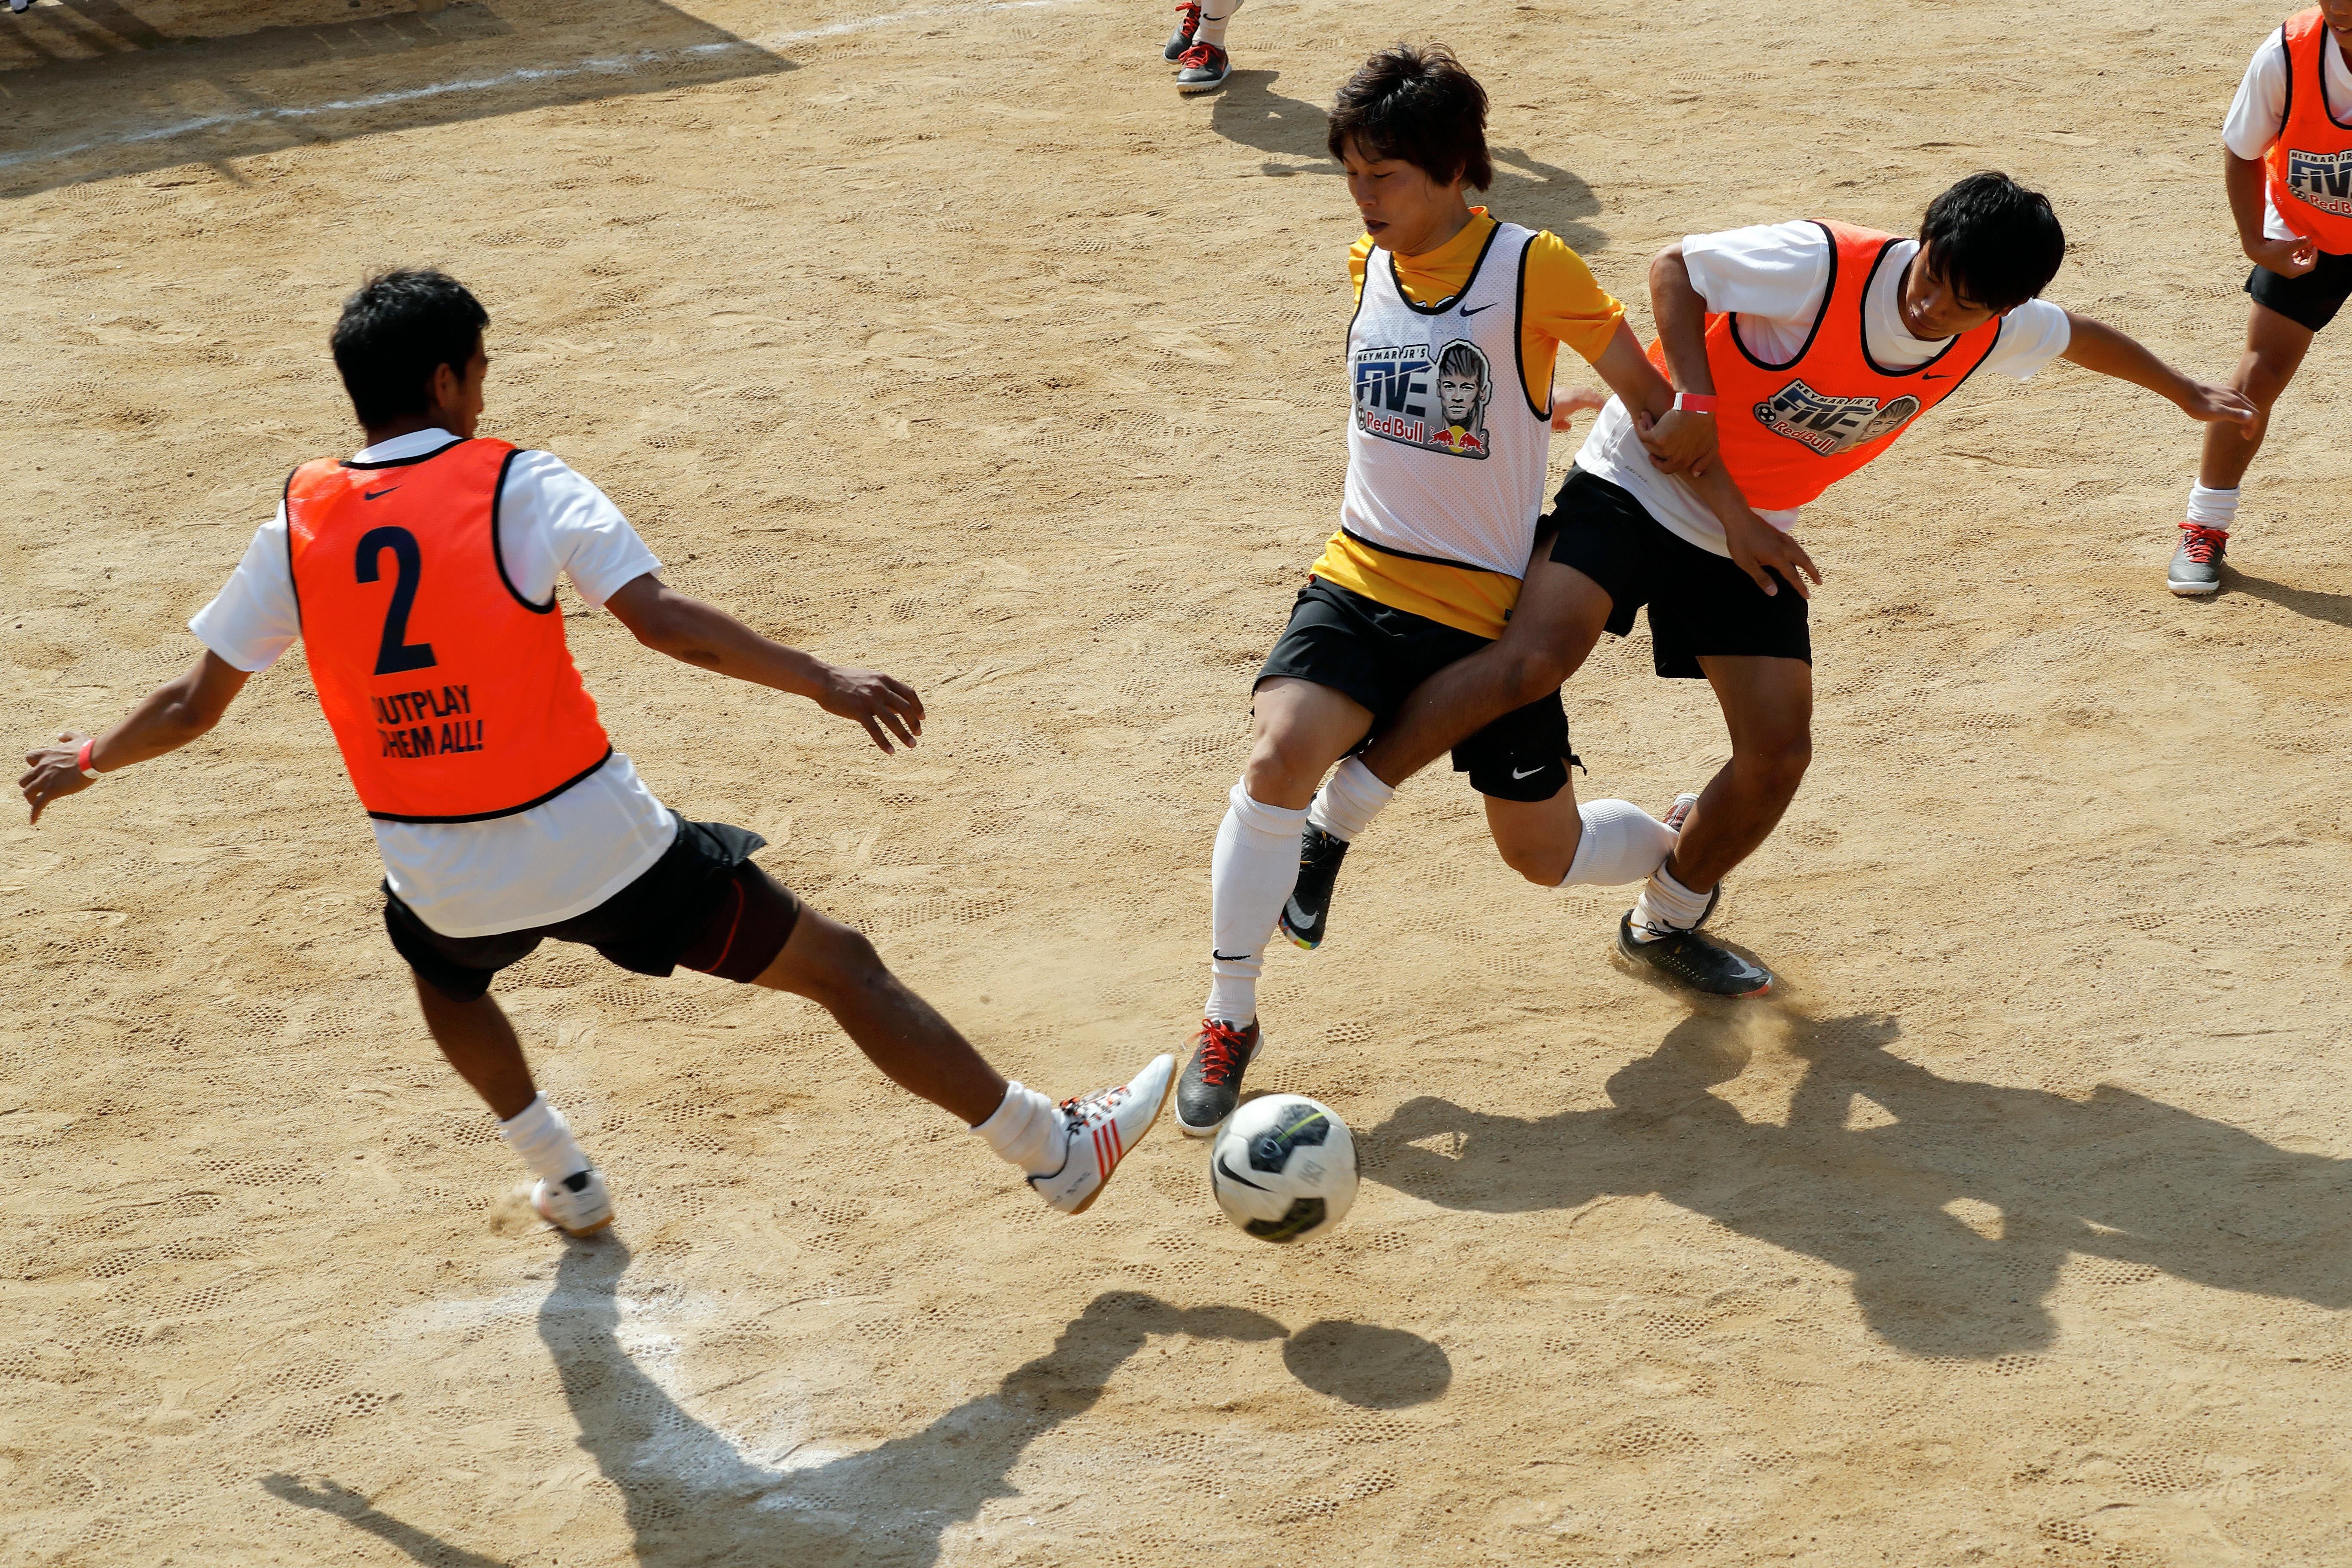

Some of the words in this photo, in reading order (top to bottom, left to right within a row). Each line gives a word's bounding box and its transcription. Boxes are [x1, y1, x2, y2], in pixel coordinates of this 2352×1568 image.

[2291, 152, 2334, 162] NEYMAR
[2291, 159, 2352, 199] FIV
[2309, 193, 2340, 213] Red
[1358, 350, 1399, 361] NEYMAR
[1403, 348, 1426, 358] JR'S
[1356, 361, 1433, 417] FIVE
[1795, 383, 1845, 404] NEYMAR
[1849, 398, 1875, 407] JR'S
[1366, 411, 1392, 434] Red
[1393, 416, 1423, 443] Bull
[1774, 386, 1874, 439] FIVE
[1772, 421, 1804, 439] Red
[1802, 431, 1836, 453] Bull
[355, 526, 438, 676] 2
[371, 684, 471, 725] UTPLAY
[440, 719, 484, 754] ALL!
